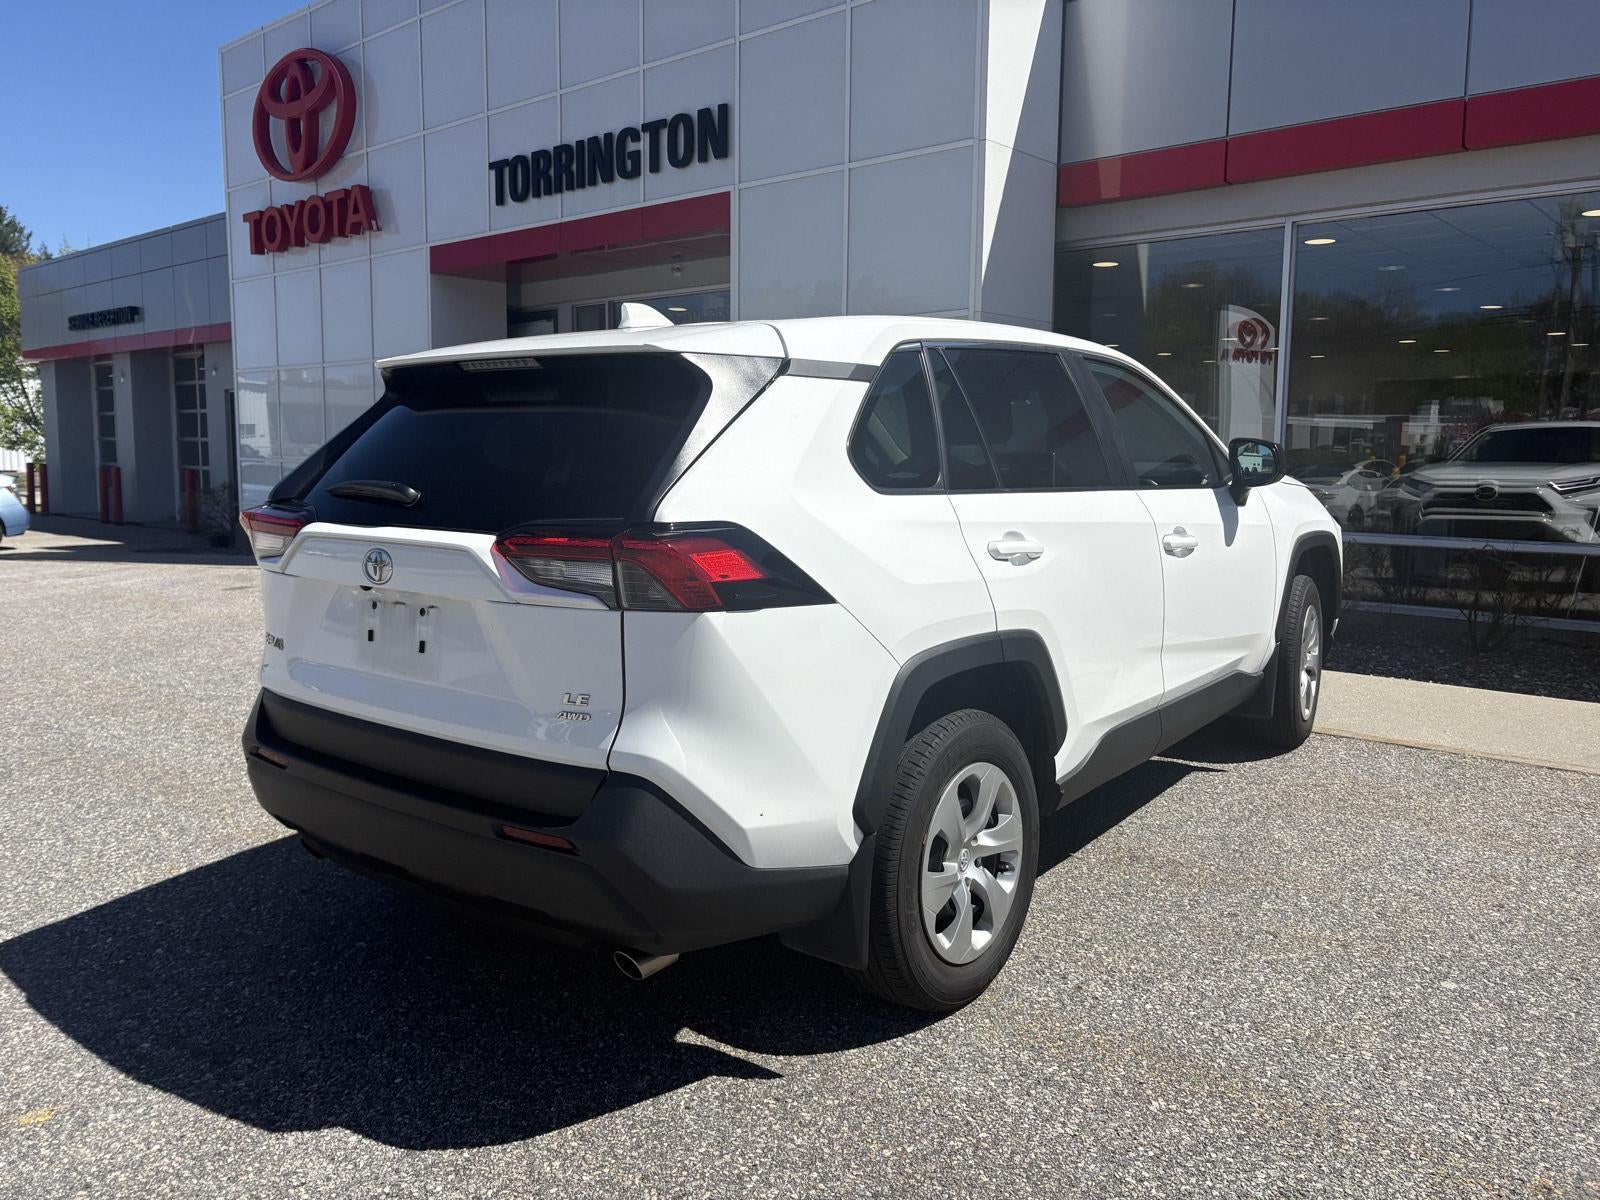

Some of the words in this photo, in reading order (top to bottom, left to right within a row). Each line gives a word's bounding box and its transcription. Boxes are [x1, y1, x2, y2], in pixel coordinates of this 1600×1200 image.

[488, 103, 728, 206] TORRINGTON
[243, 185, 380, 255] TOYOTA
[555, 710, 592, 722] AWD
[562, 692, 591, 706] LE
